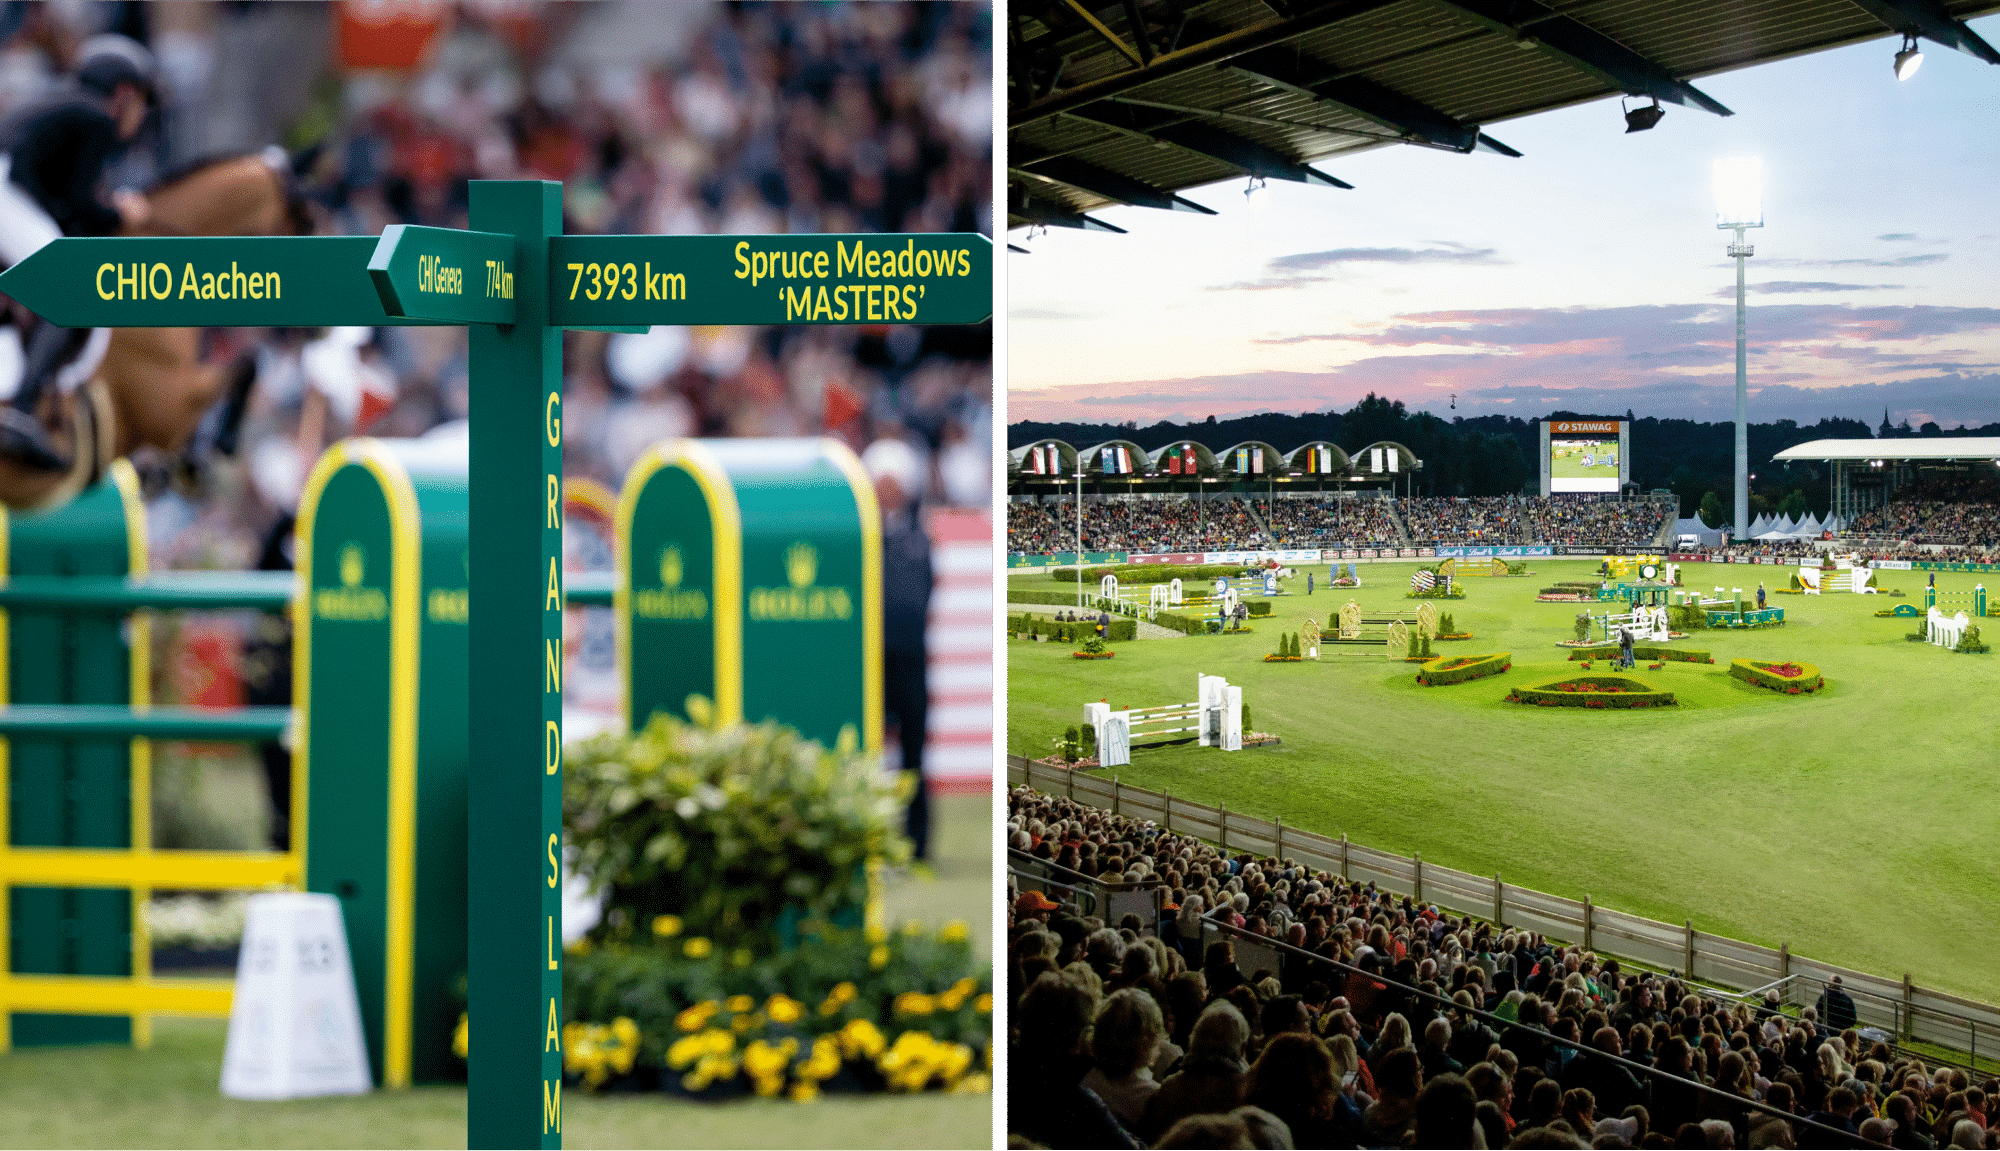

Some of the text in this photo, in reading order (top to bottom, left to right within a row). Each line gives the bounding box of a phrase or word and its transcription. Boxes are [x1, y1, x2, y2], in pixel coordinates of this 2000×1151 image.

[96, 261, 281, 300] CHIO Aachen
[418, 254, 463, 296] CHI Geneva
[486, 260, 514, 299] 774 km
[567, 261, 686, 300] 7393 km
[734, 239, 971, 286] Spruce Meadows
[1571, 422, 1612, 432] STAWAG
[1625, 547, 1665, 555] Mercedes-Benz
[543, 391, 561, 1135] GRAND SLAM
